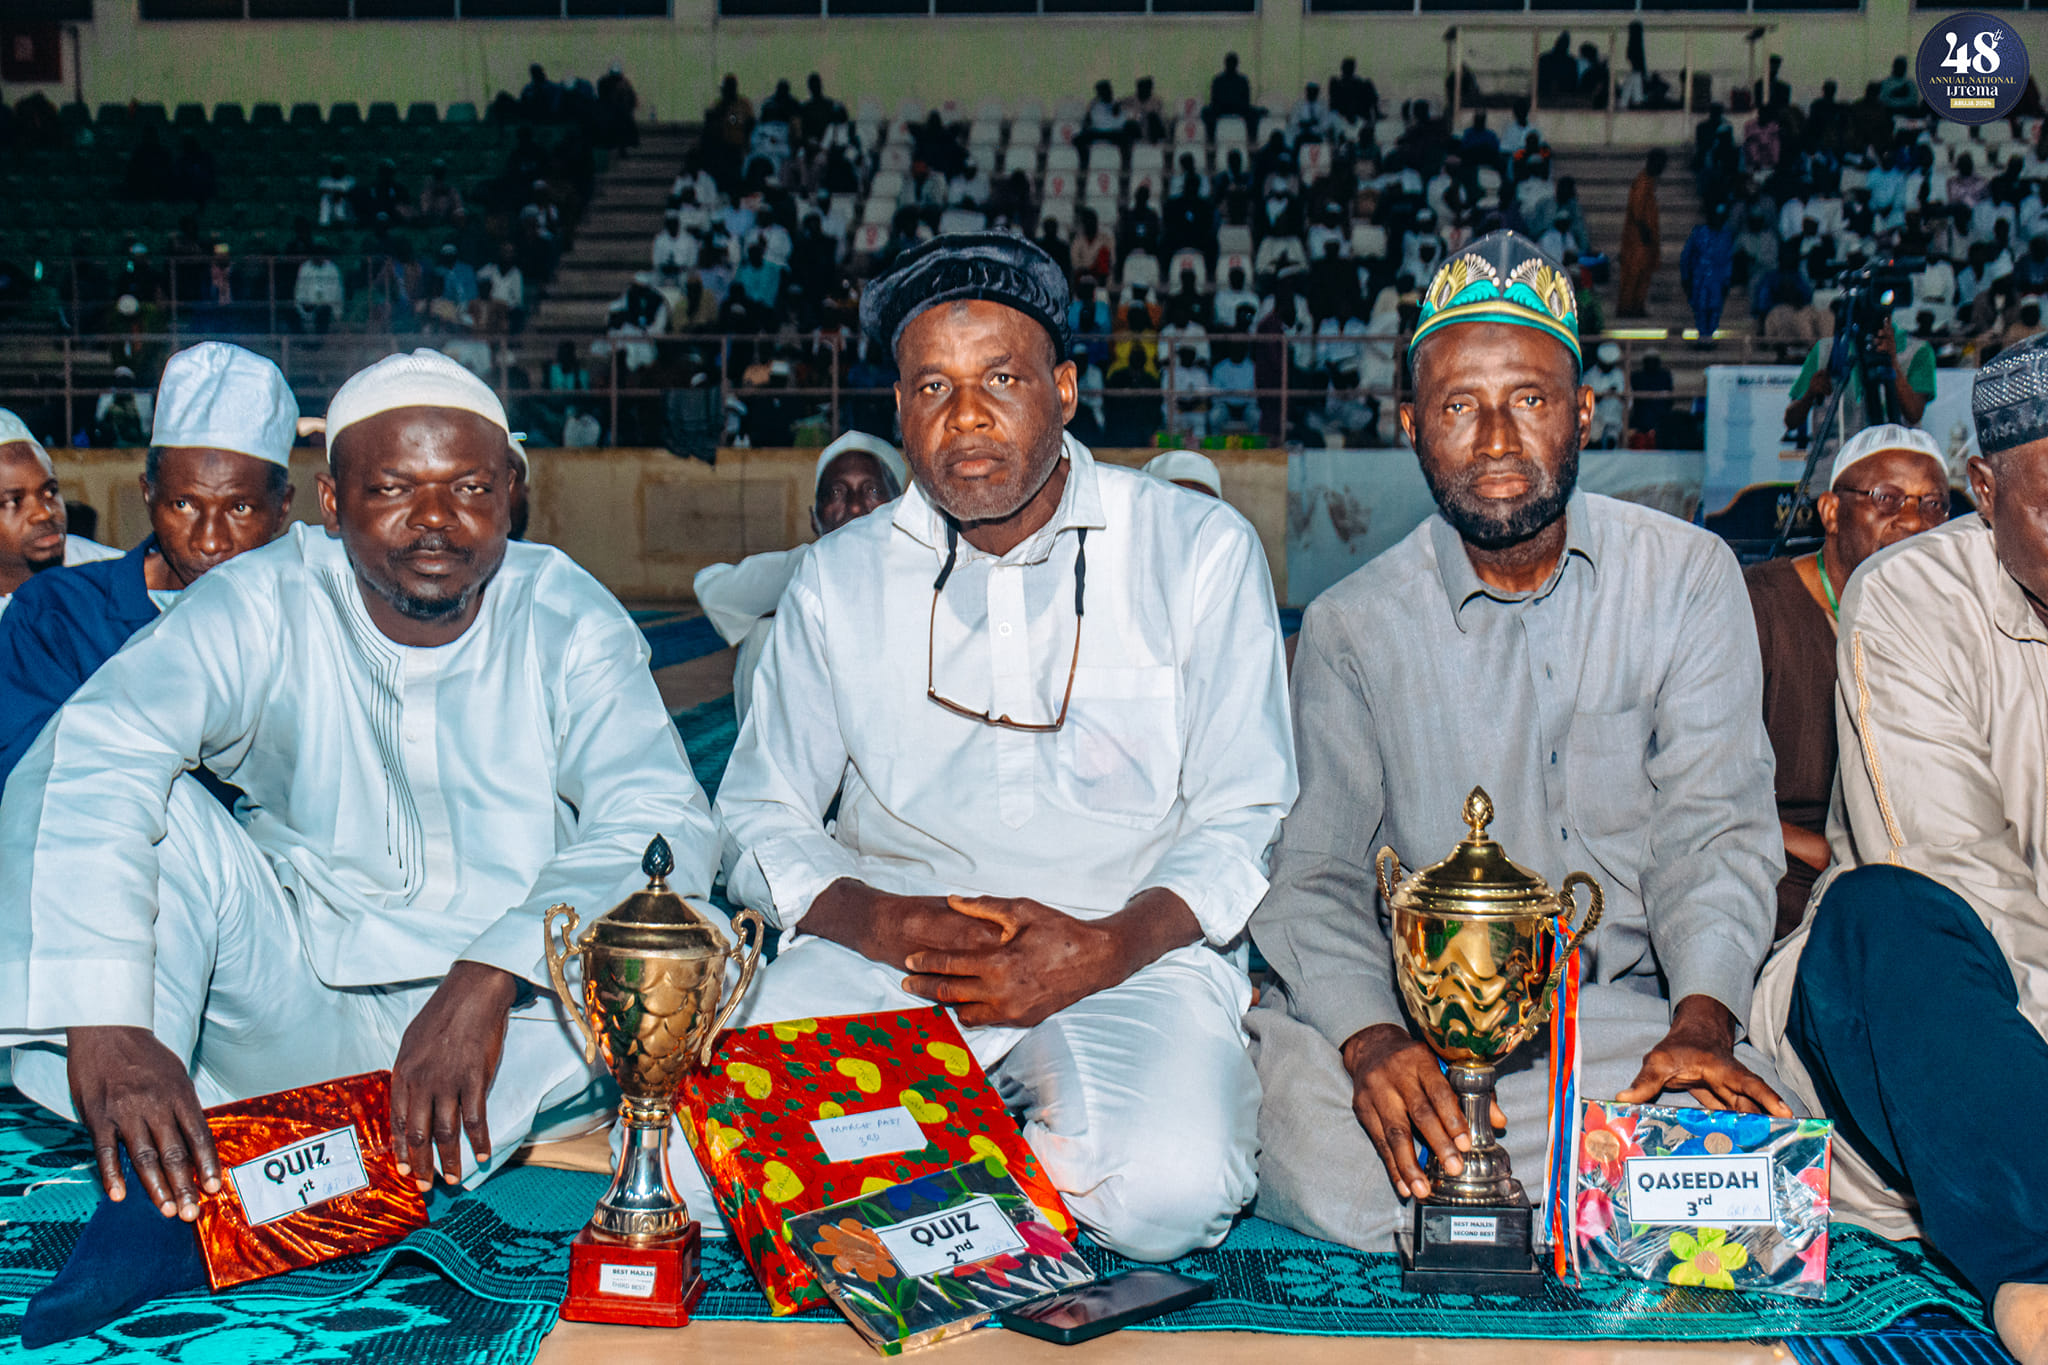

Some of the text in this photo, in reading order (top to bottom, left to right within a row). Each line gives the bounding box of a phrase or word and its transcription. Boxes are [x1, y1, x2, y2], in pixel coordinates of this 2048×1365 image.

[263, 1142, 331, 1185] QUIZ
[297, 1178, 316, 1205] 1st
[1638, 1171, 1759, 1193] QASEEDAH
[1687, 1194, 1713, 1217] 3rd
[910, 1211, 980, 1247] QUIZ
[946, 1239, 975, 1265] 2nd
